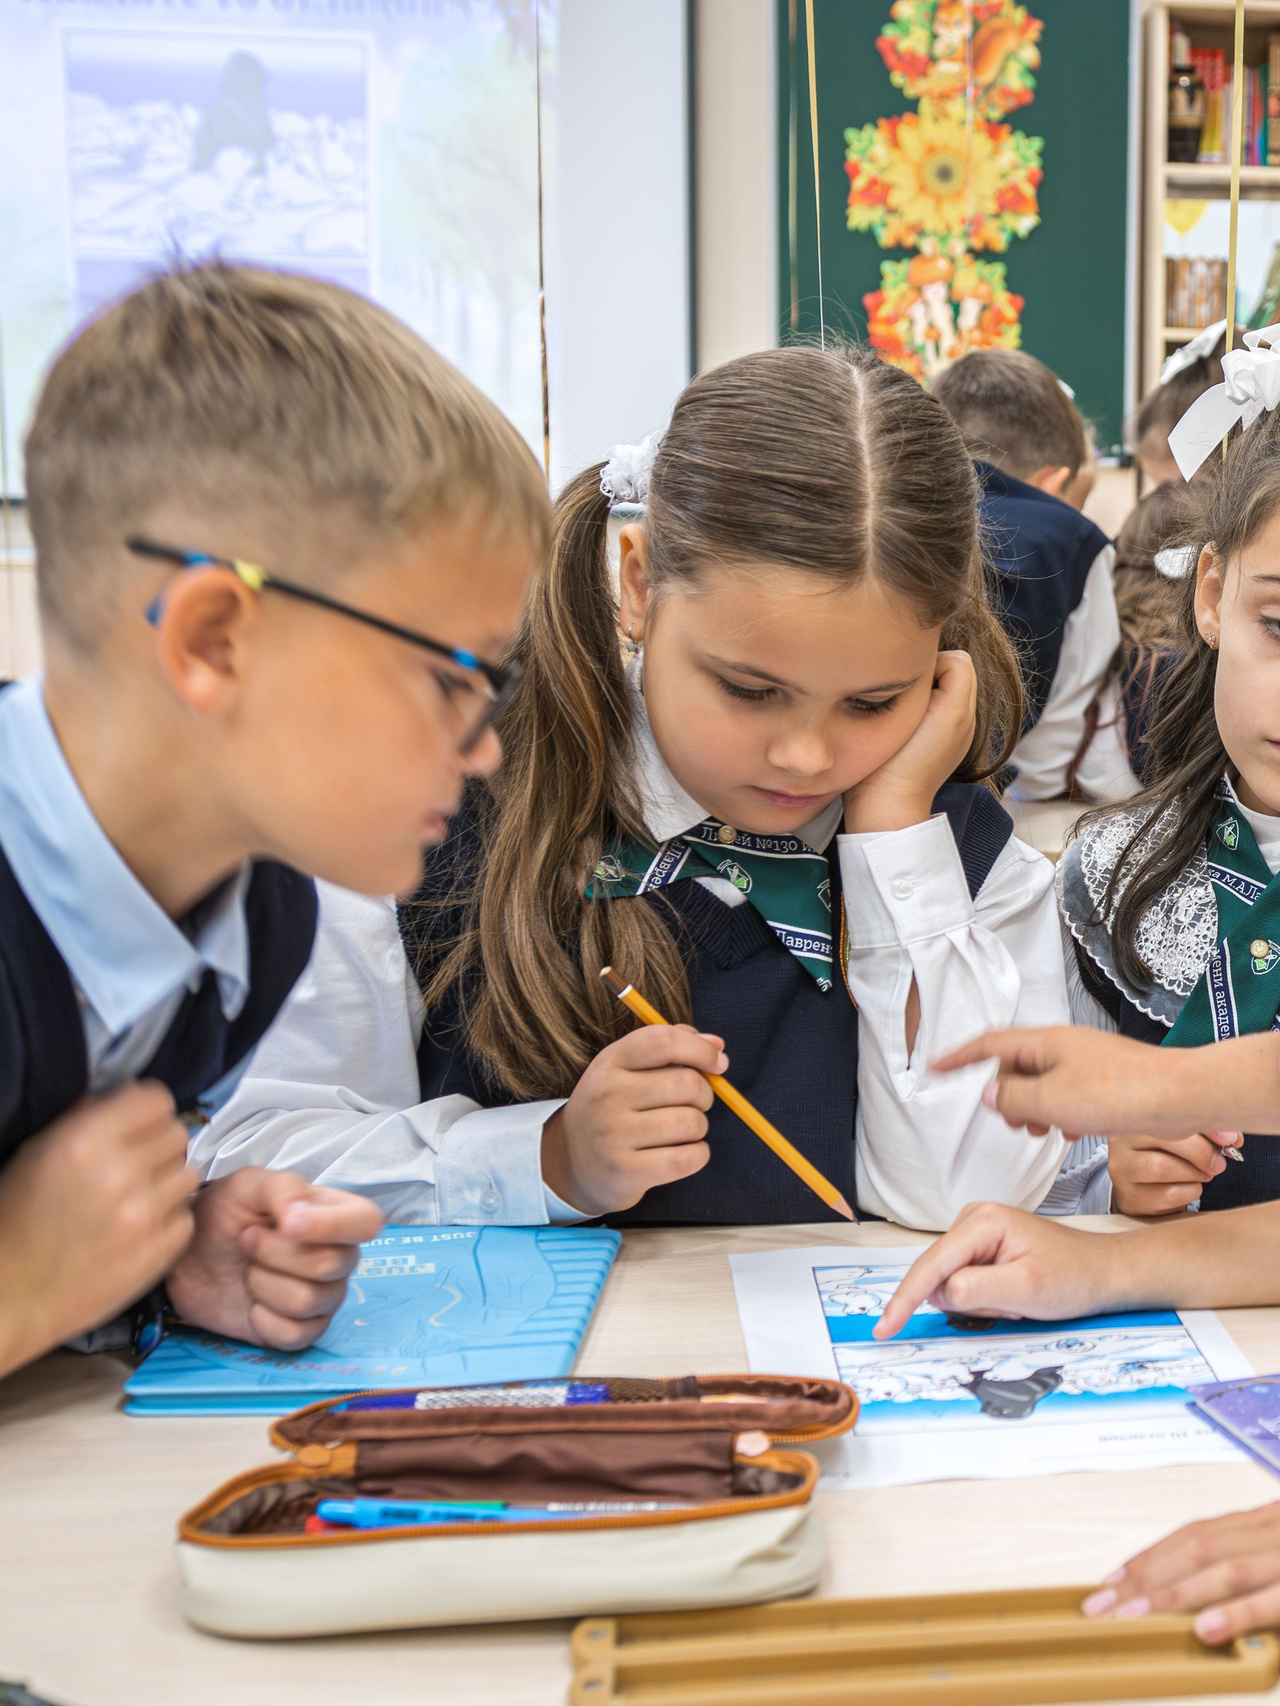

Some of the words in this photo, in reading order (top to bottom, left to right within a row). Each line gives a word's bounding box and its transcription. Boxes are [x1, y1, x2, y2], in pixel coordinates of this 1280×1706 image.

[700, 826, 753, 847] Лией
[755, 837, 798, 853] №130
[401, 1235, 424, 1244] BE
[430, 1230, 477, 1242] JUST
